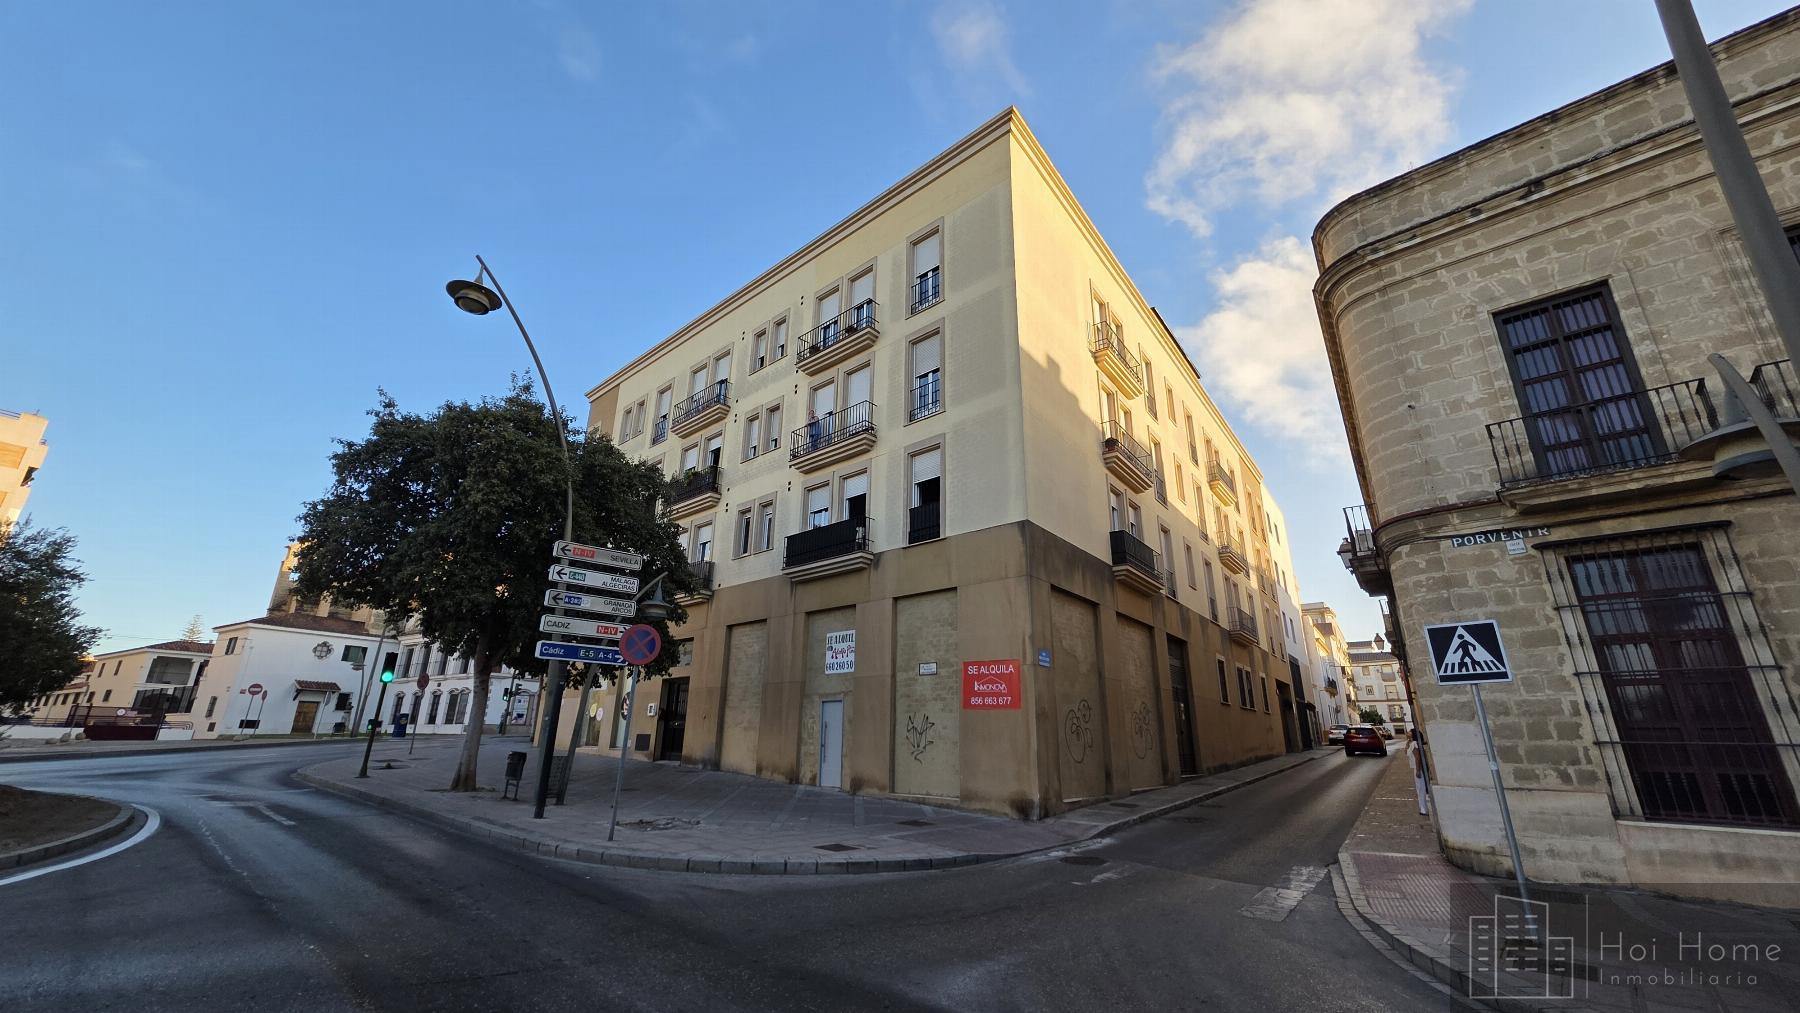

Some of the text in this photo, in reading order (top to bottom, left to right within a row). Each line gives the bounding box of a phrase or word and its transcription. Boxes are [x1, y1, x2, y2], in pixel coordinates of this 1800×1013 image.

[1452, 527, 1551, 547] PORVENIR
[574, 548, 639, 565] N-IV SEVILLA
[601, 581, 635, 592] ALGECIRAS
[603, 599, 634, 608] GRANADA
[611, 606, 633, 615] ARCOS
[598, 626, 617, 635] N-IV
[542, 645, 613, 660] Cádiz E-5 A-4
[967, 664, 1015, 675] SE ALQUILA
[970, 696, 1012, 705] 856 663 677
